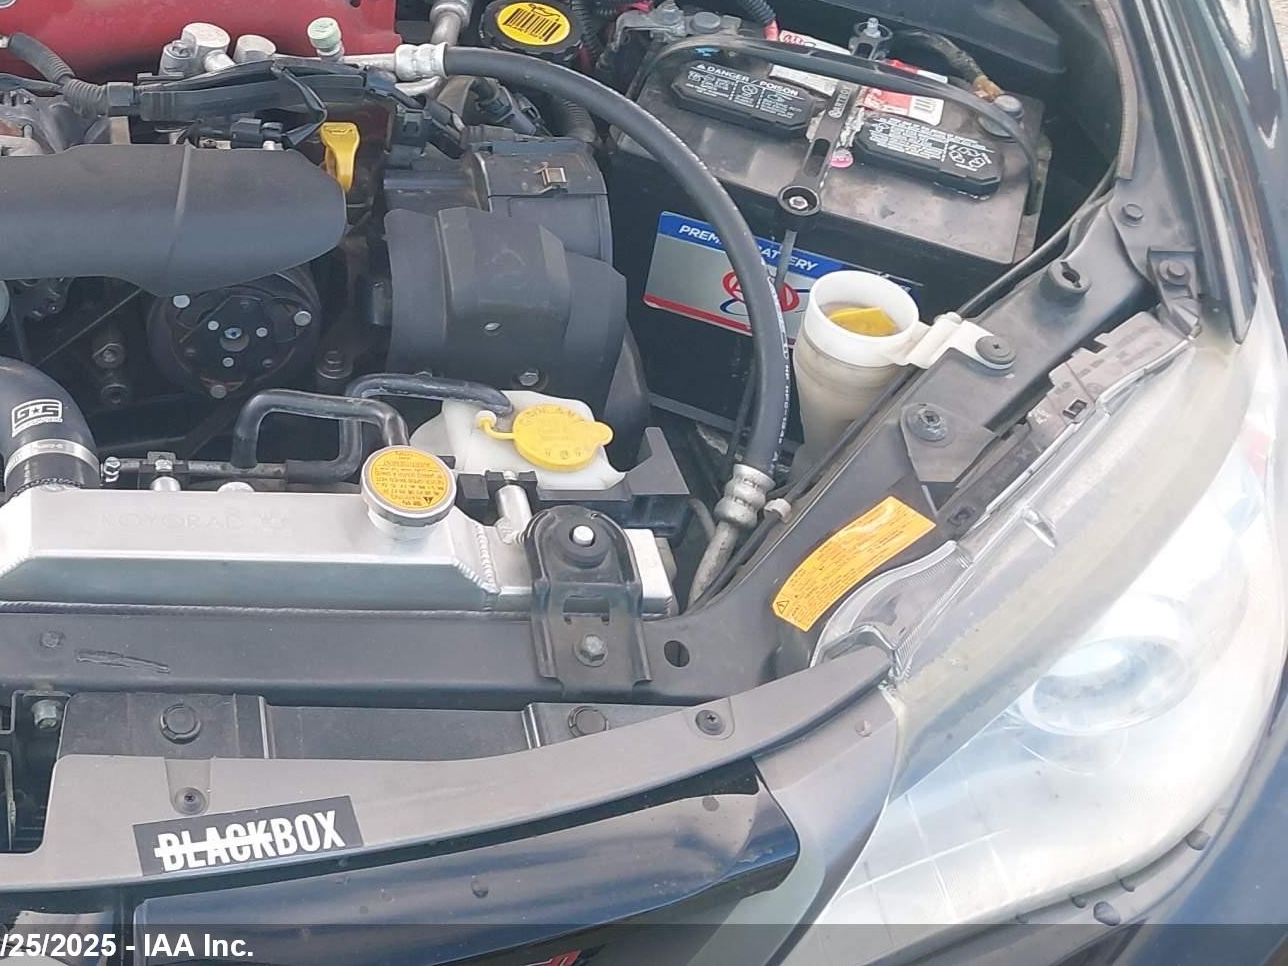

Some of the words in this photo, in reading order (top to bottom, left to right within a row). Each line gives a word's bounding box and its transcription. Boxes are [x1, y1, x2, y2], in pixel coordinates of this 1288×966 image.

[706, 65, 751, 82] DANGER
[759, 80, 799, 97] POISON
[156, 809, 346, 873] BLACKBOX
